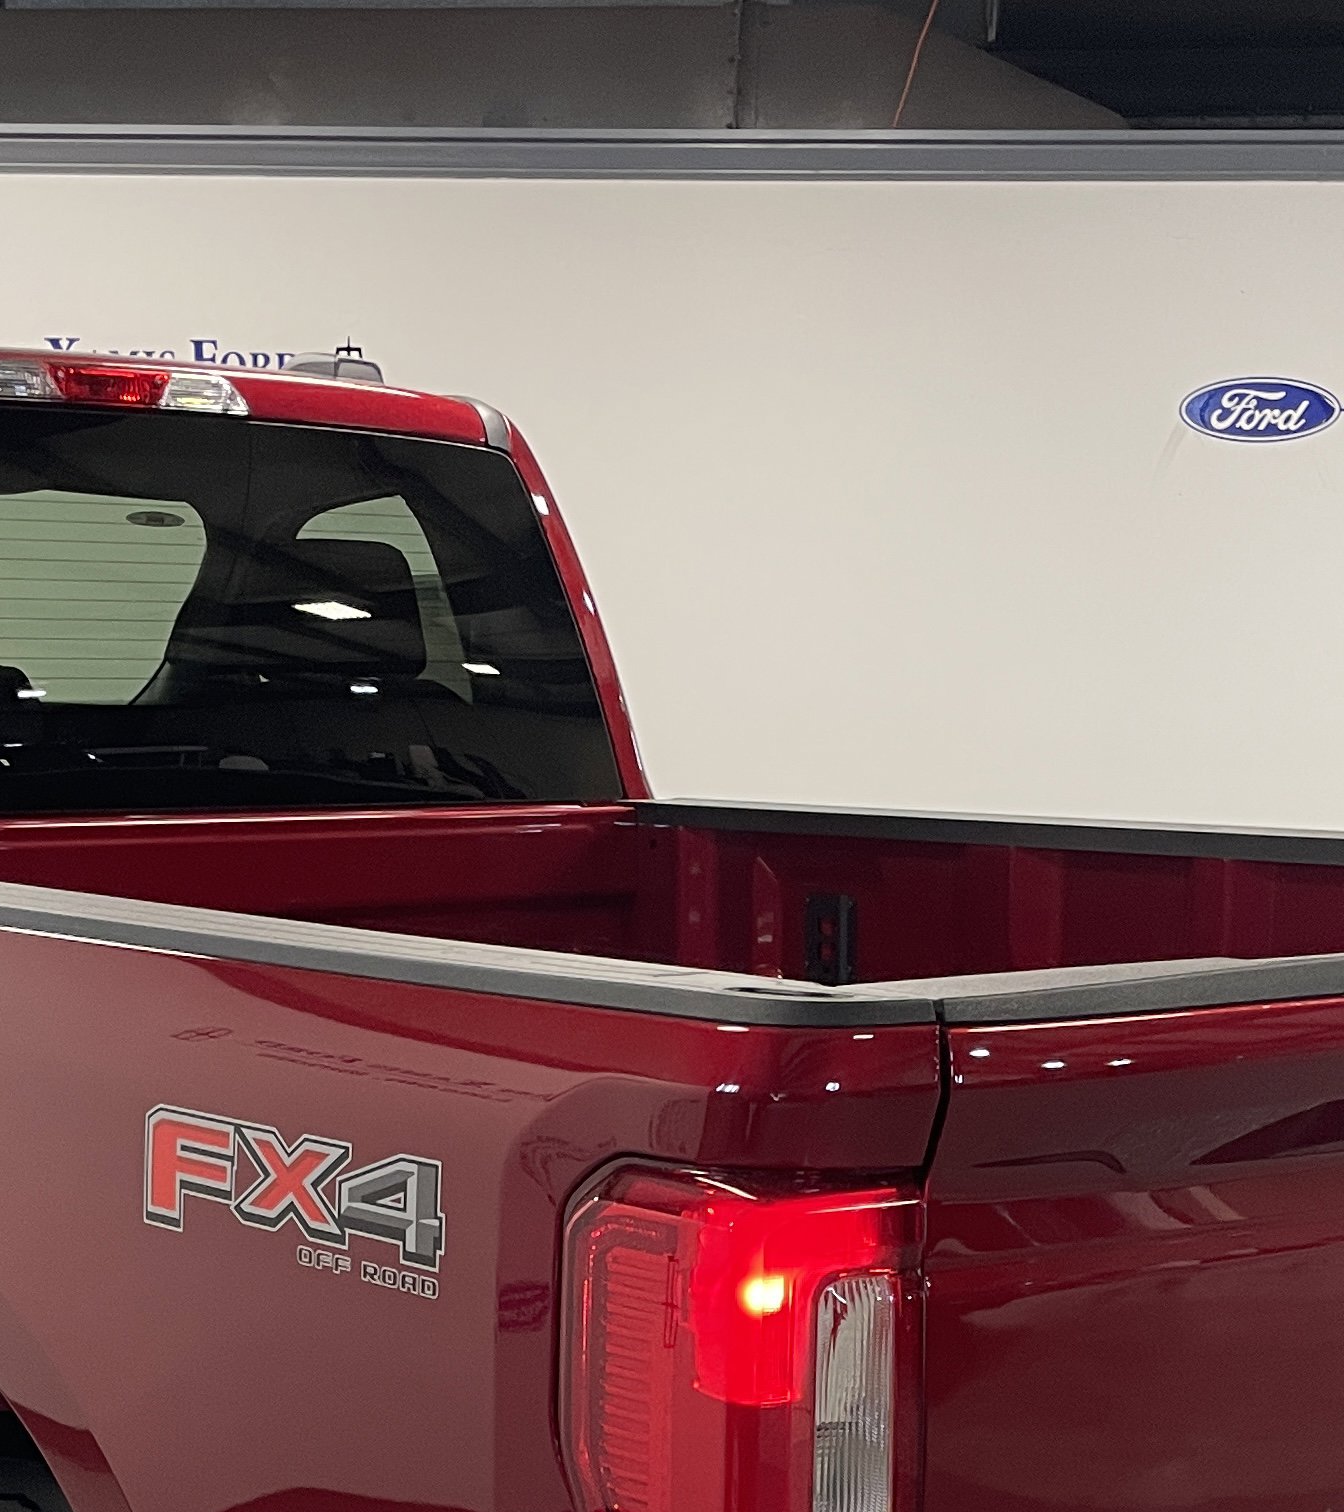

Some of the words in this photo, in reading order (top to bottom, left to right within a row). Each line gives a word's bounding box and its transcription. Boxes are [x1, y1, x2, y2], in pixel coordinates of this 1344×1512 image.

[1210, 387, 1312, 433] Ford
[143, 1103, 445, 1273] FX4
[297, 1245, 351, 1274] OFF
[361, 1261, 439, 1300] ROAD
